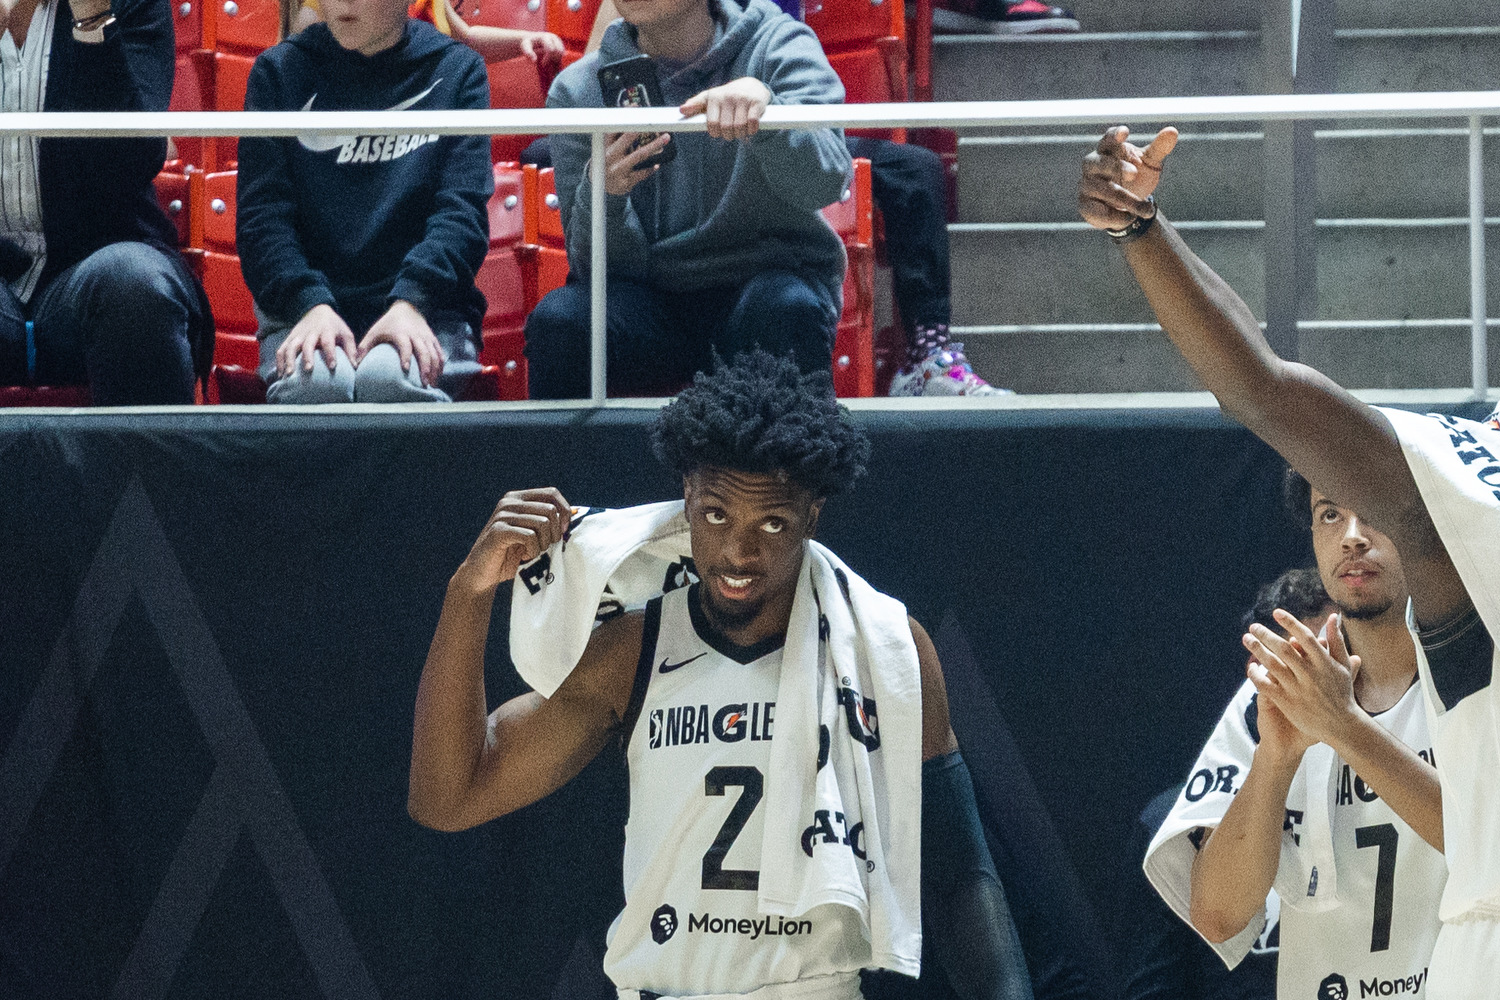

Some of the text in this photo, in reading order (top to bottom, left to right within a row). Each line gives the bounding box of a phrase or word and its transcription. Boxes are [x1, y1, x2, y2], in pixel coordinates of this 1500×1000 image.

[665, 704, 709, 748] NBA
[700, 765, 764, 891] 2
[687, 912, 813, 940] MoneyLion
[1355, 822, 1400, 953] 7
